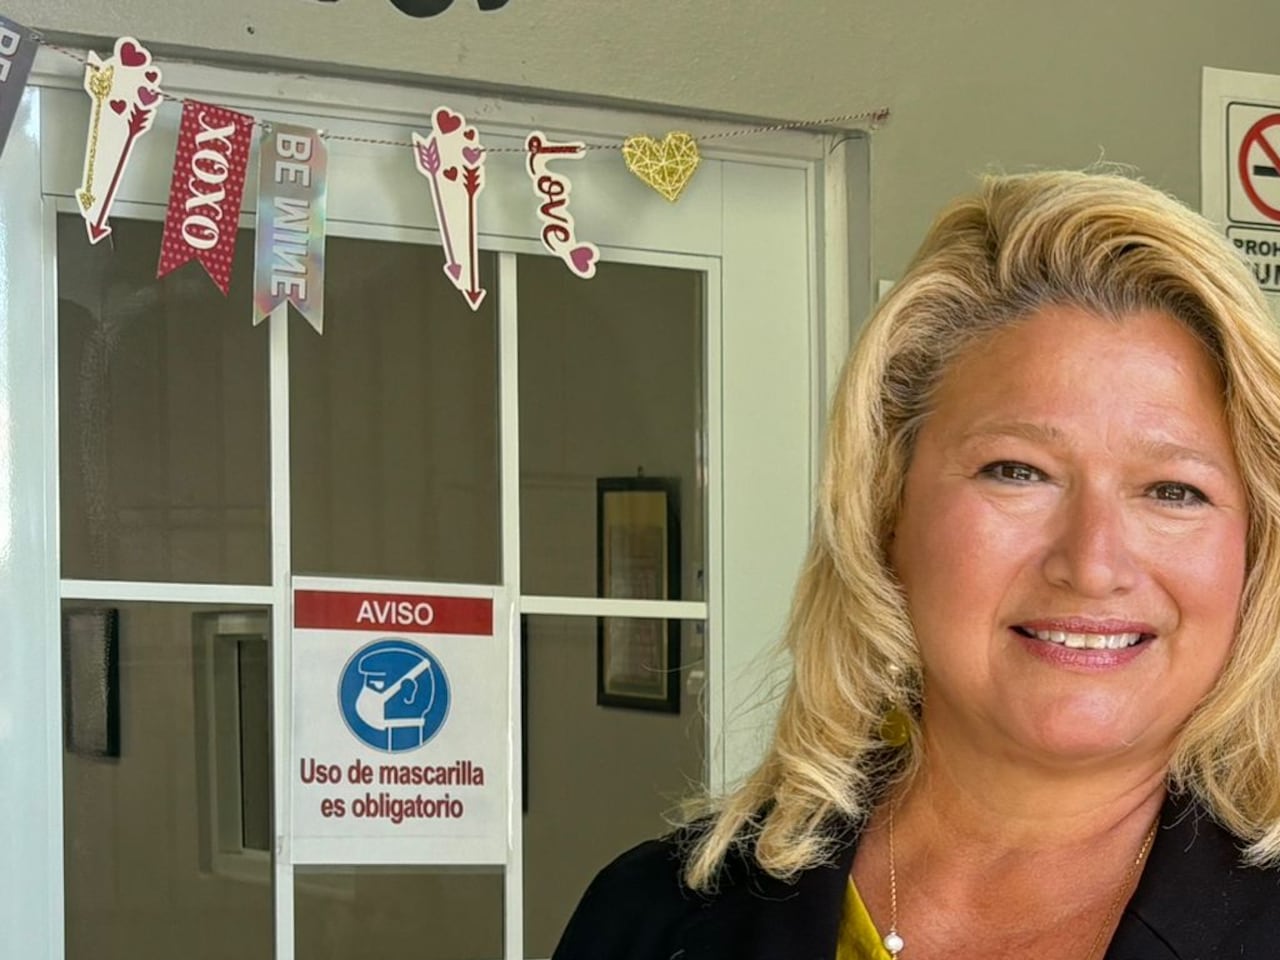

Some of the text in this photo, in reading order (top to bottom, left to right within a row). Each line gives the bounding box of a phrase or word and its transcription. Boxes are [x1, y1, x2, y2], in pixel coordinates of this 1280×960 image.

[181, 111, 236, 250] XOXO
[270, 132, 313, 301] BE MINE
[527, 135, 583, 253] Love
[356, 600, 435, 626] AVISO
[300, 758, 484, 786] Uso de mascarilla
[320, 793, 464, 824] es obligatorio
